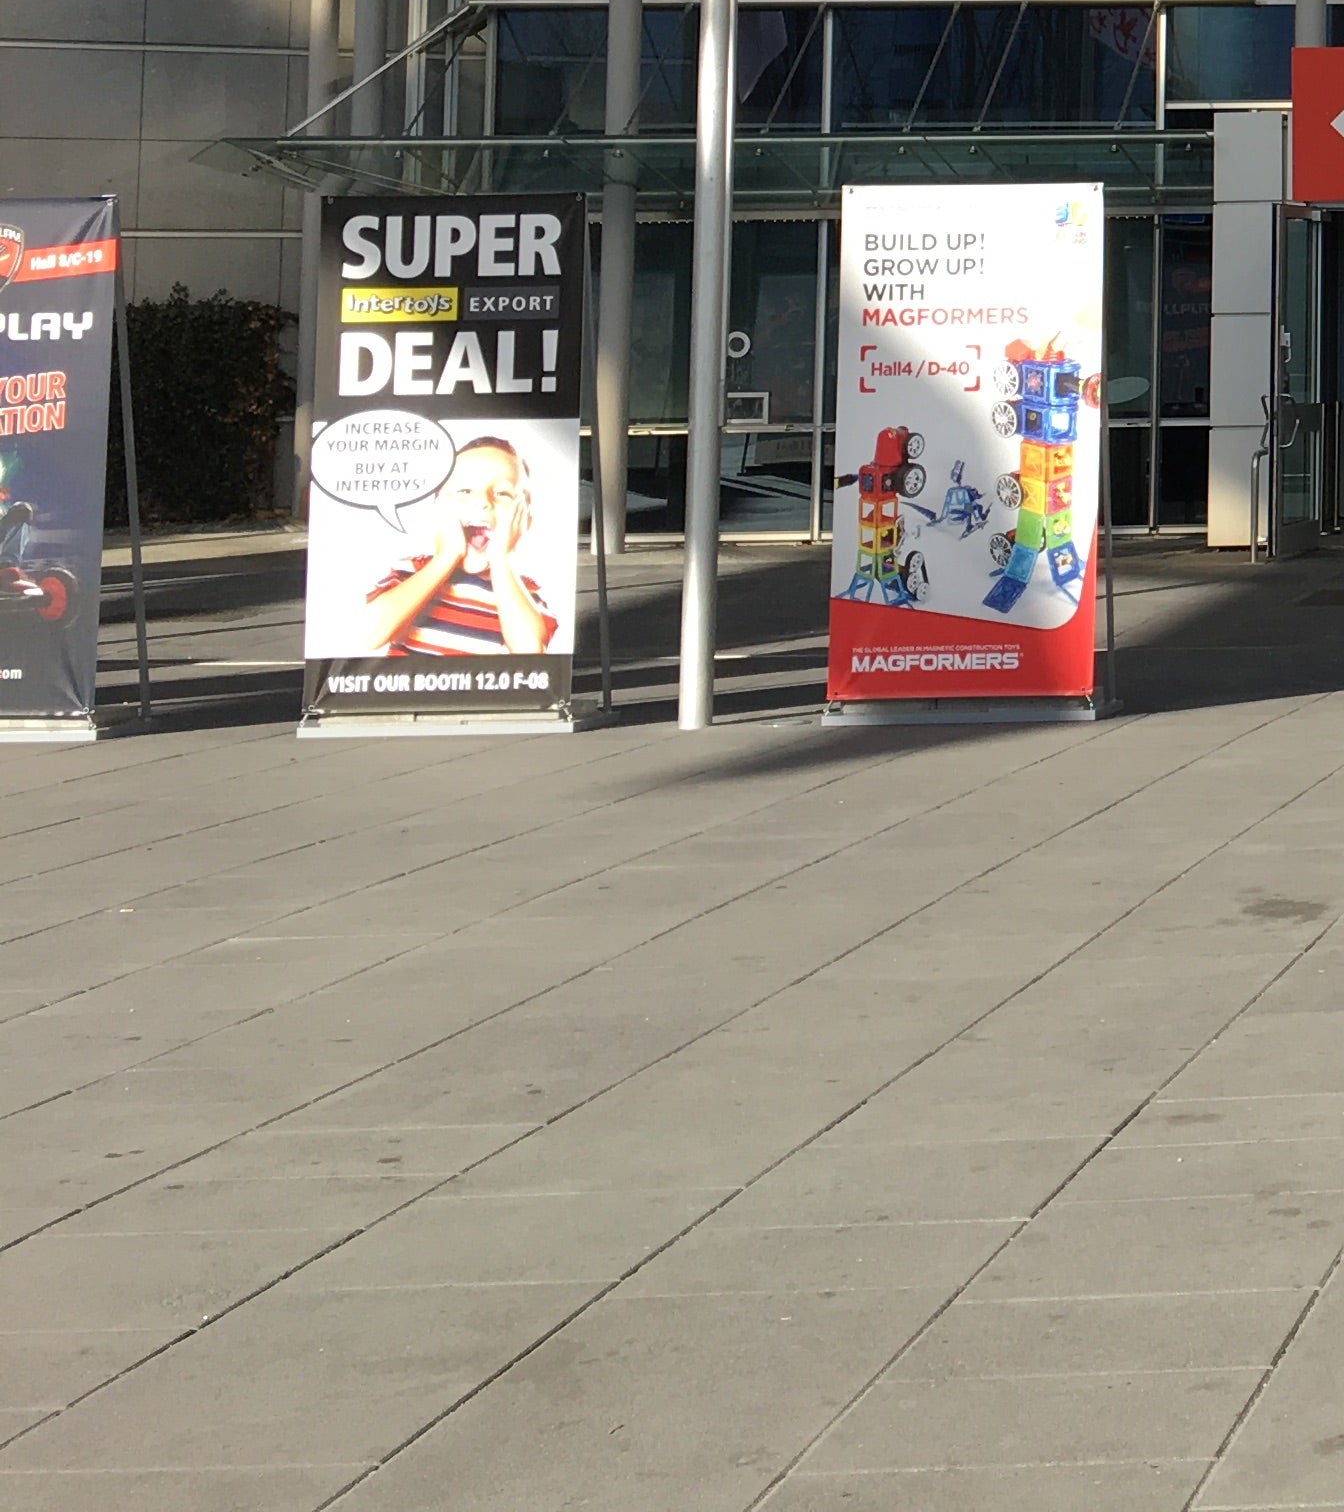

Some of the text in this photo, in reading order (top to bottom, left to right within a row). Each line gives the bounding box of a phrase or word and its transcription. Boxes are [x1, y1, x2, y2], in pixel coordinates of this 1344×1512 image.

[341, 213, 562, 279] SUPER
[864, 233, 985, 251] BUILD UP!
[30, 254, 57, 271] Hall
[863, 258, 985, 276] GROW UP!
[863, 283, 925, 301] WITH
[347, 294, 554, 316] Intertoys EXPORT
[0, 311, 93, 341] LAY
[862, 307, 1029, 327] MAGFORMERS
[338, 329, 559, 397] DEAL!
[927, 361, 970, 376] D-40
[345, 422, 422, 434] INCREASE
[327, 439, 440, 452] YOUR MARGIN
[355, 462, 409, 474] BUY AT
[851, 652, 1019, 673] MAGFORMERS
[328, 672, 549, 693] VISIT OUR BOOTH 12.0 F-08
